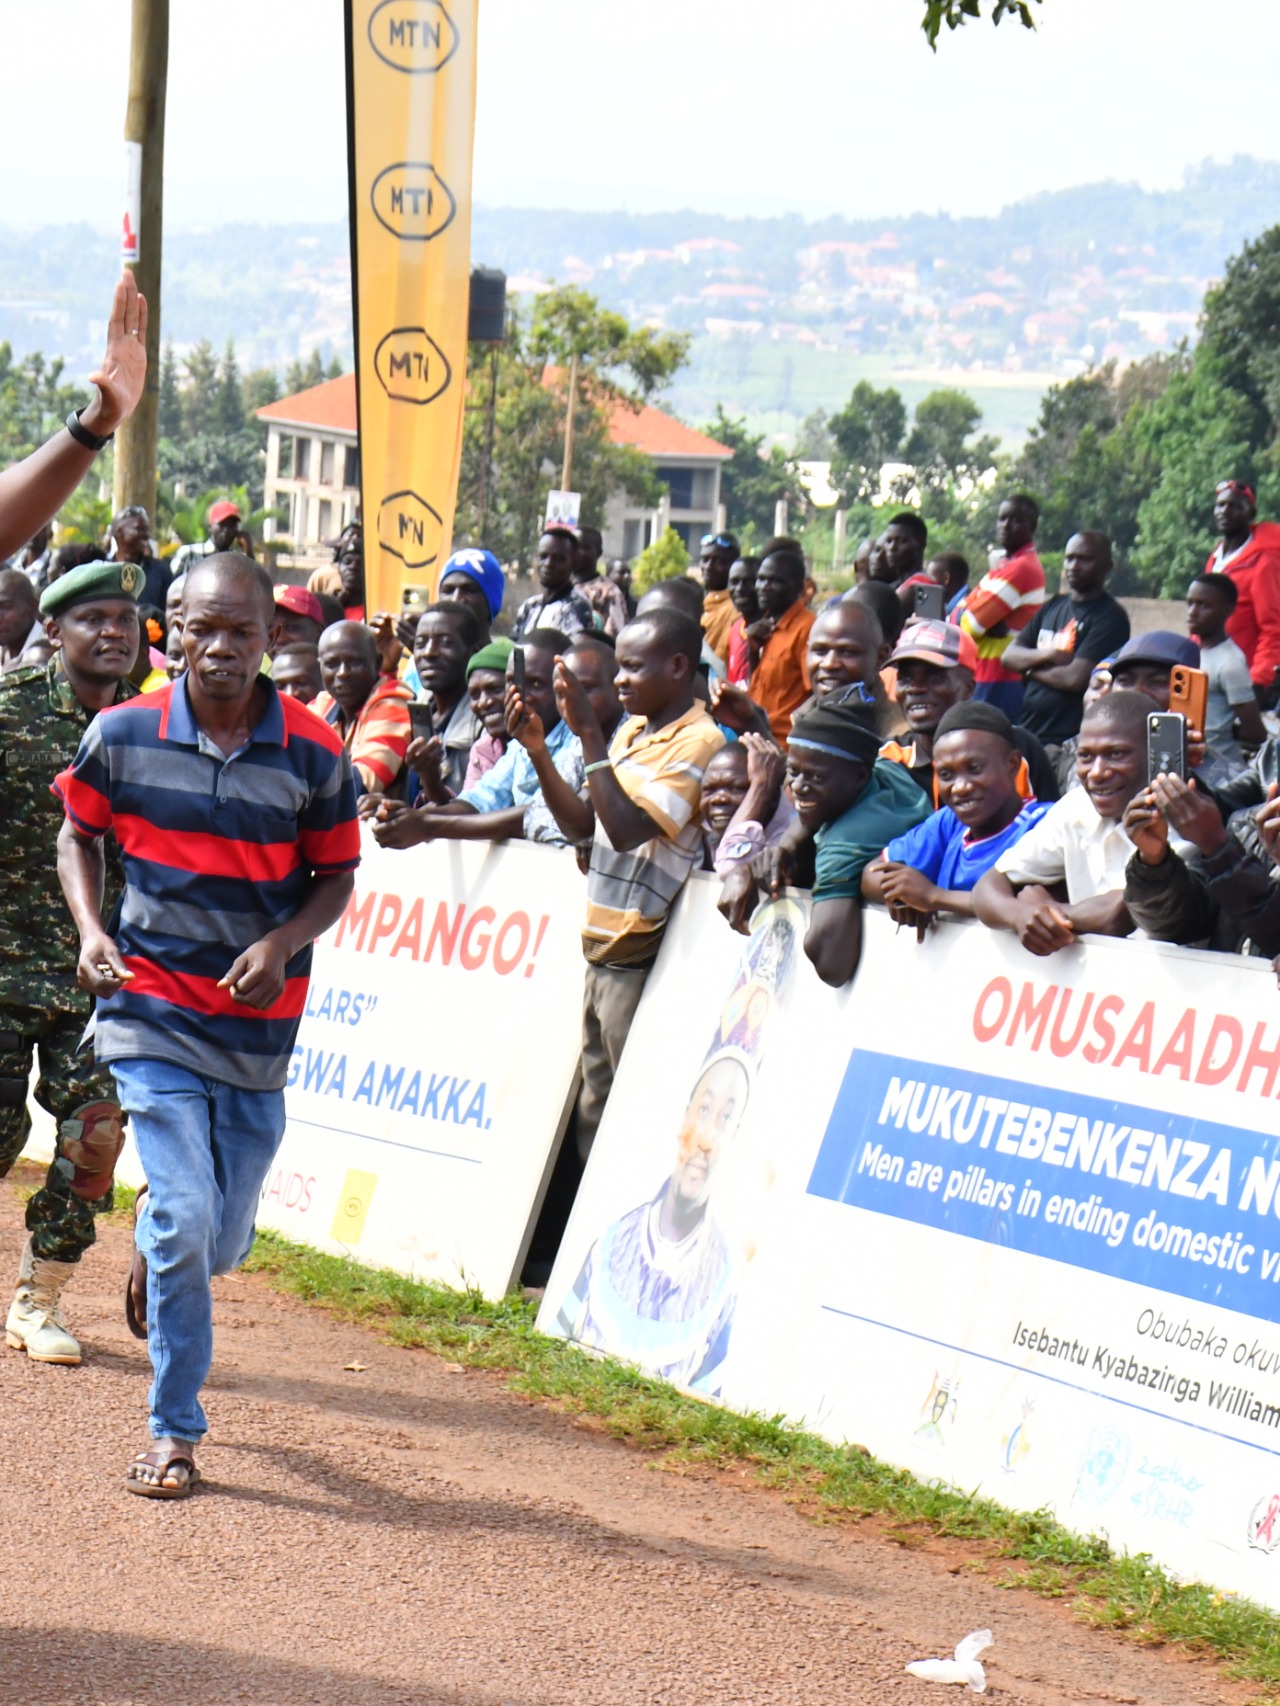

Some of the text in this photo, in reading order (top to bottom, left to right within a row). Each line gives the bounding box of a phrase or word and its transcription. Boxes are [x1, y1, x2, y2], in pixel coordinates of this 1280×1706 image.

[389, 18, 441, 48] MTN
[334, 888, 551, 979] MPANGO!
[286, 1045, 493, 1130] GWA AMAKKA.
[972, 975, 1280, 1101] OMUSAADH
[877, 1076, 1280, 1222] MUKUTEBENKENZA N
[857, 1141, 905, 1183] Men
[905, 1160, 944, 1193] are
[942, 1164, 1016, 1211] pillars
[1016, 1178, 1042, 1218] in
[1044, 1193, 1131, 1248] ending
[1132, 1209, 1256, 1274] domestic
[1012, 1321, 1280, 1429] Isebantu Kyabazinga William
[1136, 1308, 1228, 1358] Obubaka
